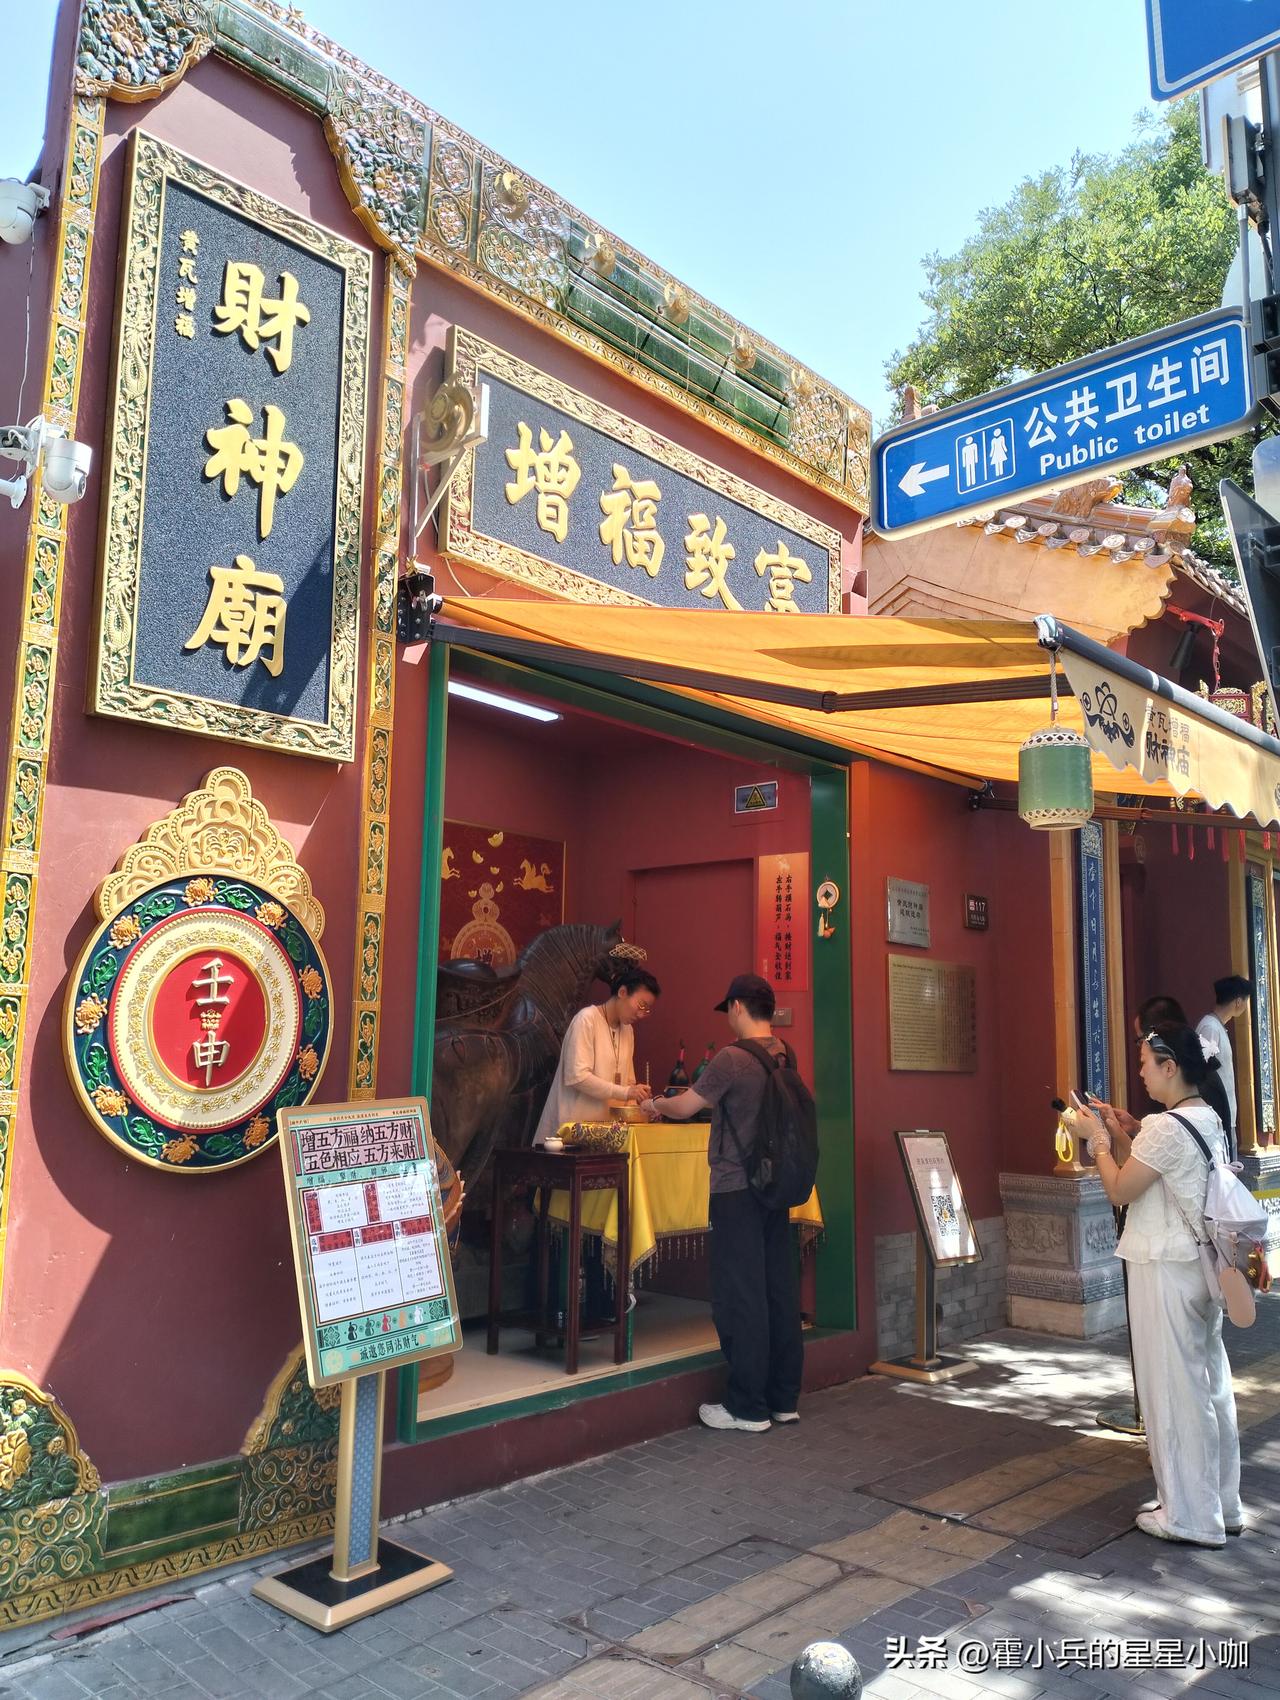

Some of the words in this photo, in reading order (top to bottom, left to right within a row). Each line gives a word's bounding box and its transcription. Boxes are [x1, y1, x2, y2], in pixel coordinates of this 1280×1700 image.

[1023, 337, 1230, 450] 公共卫生间
[1039, 434, 1120, 476] Public
[1133, 403, 1210, 445] toilet
[184, 259, 310, 678] 財神廟
[192, 957, 235, 1088] 壬申
[301, 1128, 359, 1153] 增五方福
[360, 1120, 413, 1145] 纳五方财
[304, 1148, 362, 1172] 五色相应
[364, 1141, 416, 1165] 五方来财
